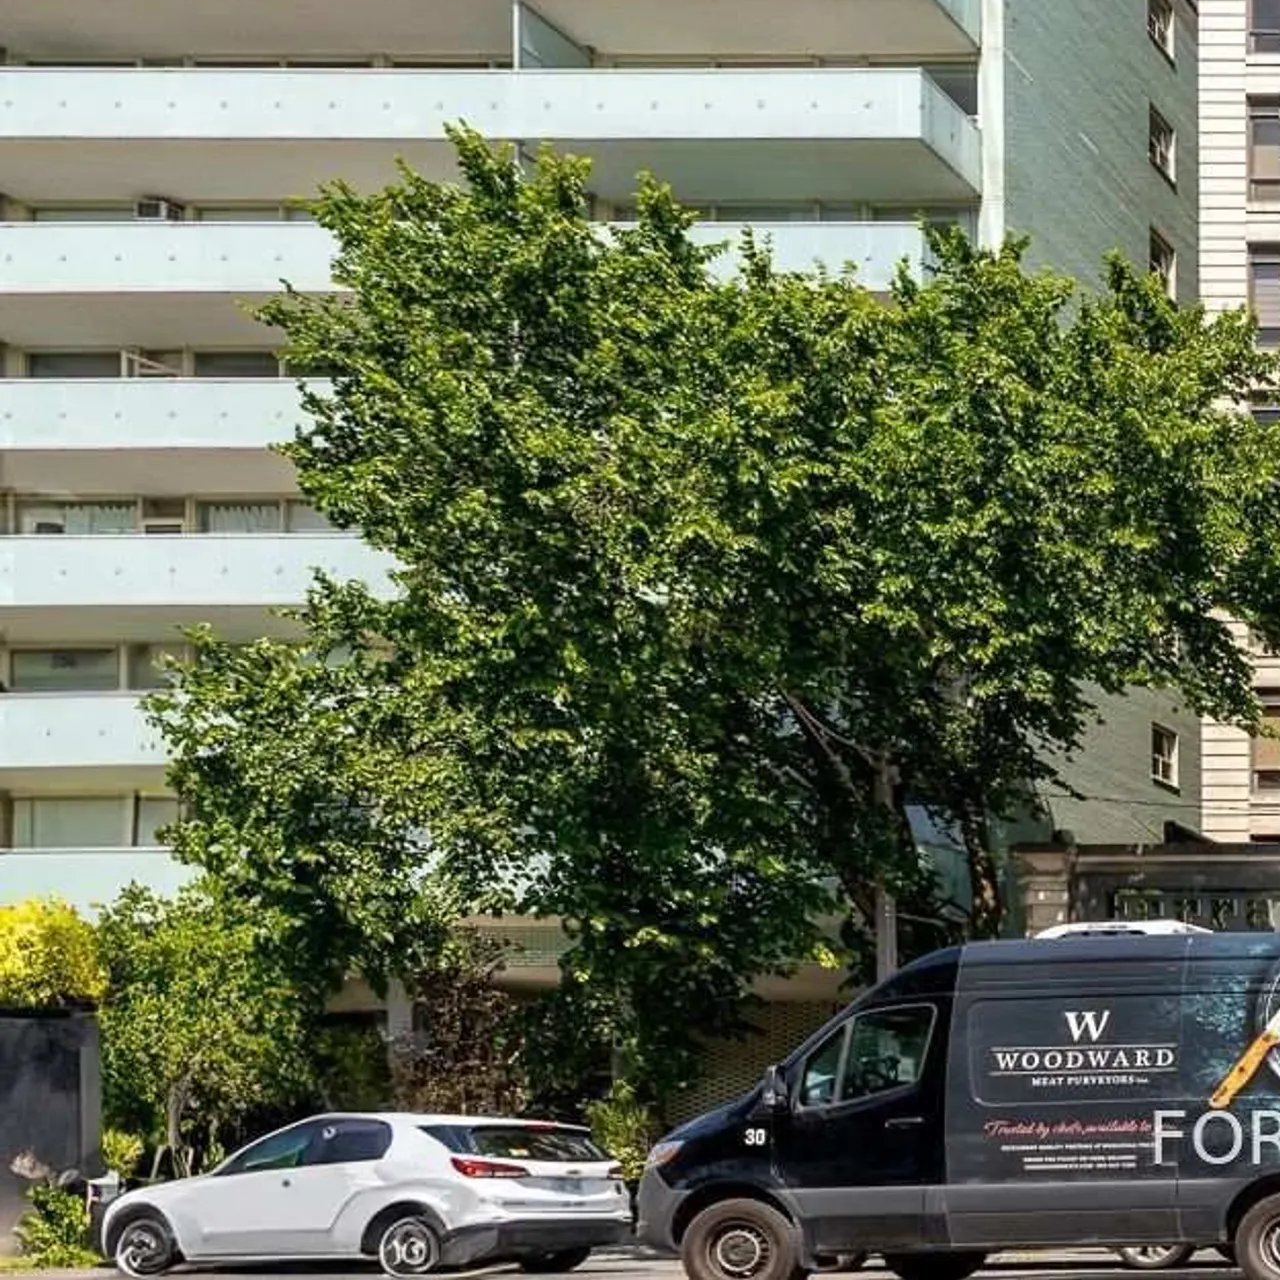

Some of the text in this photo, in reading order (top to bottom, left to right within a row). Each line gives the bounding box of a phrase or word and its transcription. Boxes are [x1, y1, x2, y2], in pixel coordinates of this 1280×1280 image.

[1064, 1009, 1111, 1042] W
[995, 1048, 1175, 1071] WOODWARD
[1032, 1076, 1064, 1087] MEAT
[1067, 1074, 1135, 1086] PURVEYORS
[745, 1128, 766, 1146] 30
